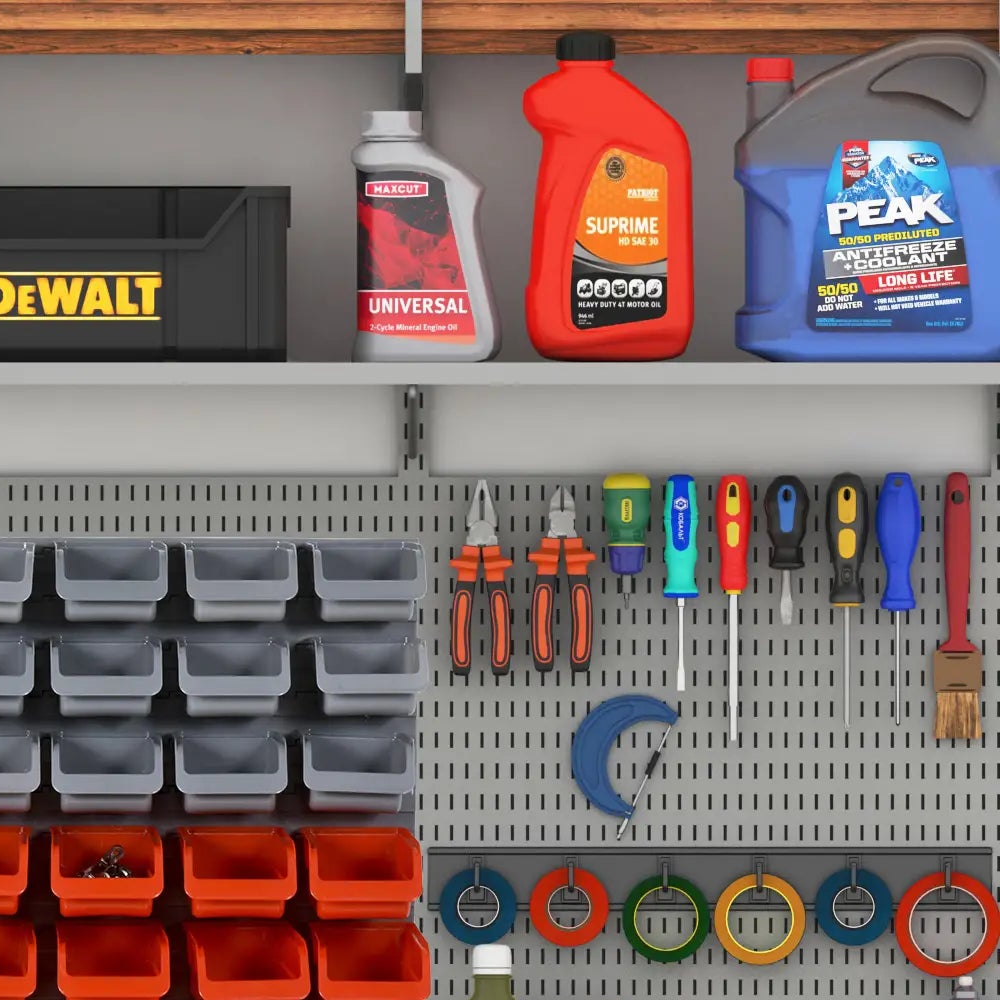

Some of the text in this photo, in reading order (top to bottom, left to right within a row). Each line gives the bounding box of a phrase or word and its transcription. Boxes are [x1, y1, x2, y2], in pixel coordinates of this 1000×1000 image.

[374, 185, 419, 193] MAXCUT
[826, 192, 954, 235] PEAK
[586, 216, 658, 234] SUPRIME
[618, 237, 659, 246] HD SAE 30
[838, 228, 940, 246] 50/50 PREDILUTED
[832, 240, 957, 262] ANTIFREEZE
[878, 269, 953, 288] LONG LIFE
[818, 282, 858, 296] 50/50
[369, 297, 467, 314] UNIVERSAL
[817, 302, 863, 312] ADD WATER
[370, 324, 395, 332] 2-Cycle
[423, 324, 446, 332] Engine
